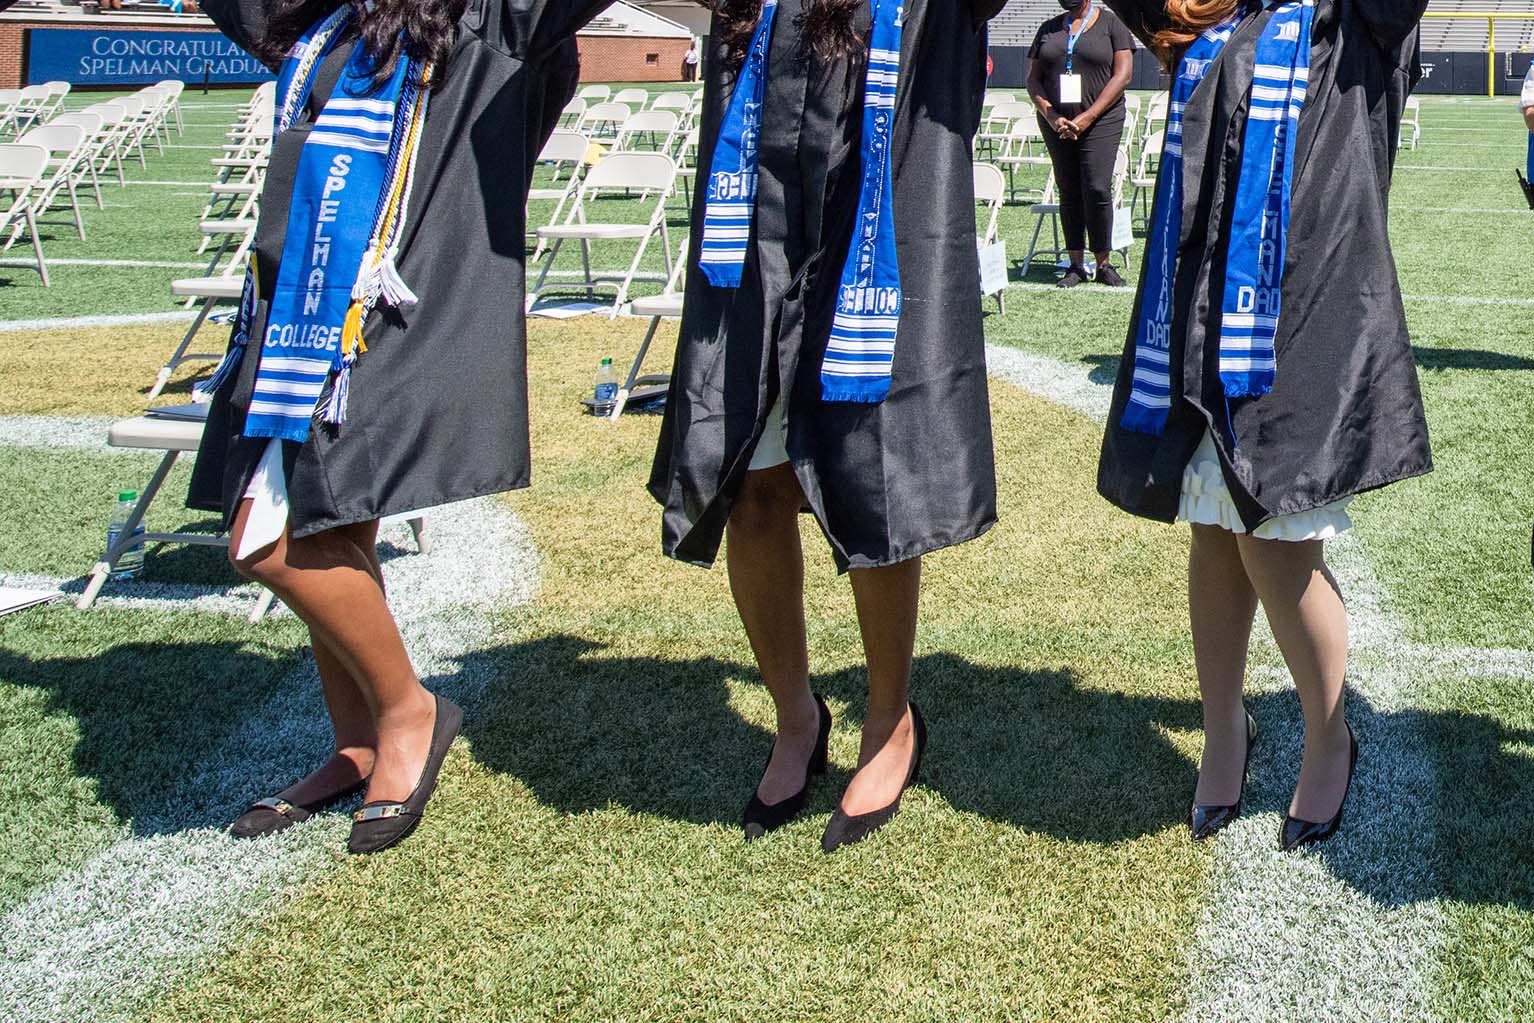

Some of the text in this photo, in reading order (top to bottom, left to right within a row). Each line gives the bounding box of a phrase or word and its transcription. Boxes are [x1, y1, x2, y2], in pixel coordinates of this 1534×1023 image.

[92, 36, 247, 56] CONGRATULA
[80, 56, 270, 75] SPELMAN GRADUA
[303, 153, 353, 316] SPELMAN
[265, 323, 341, 352] COLLEGE
